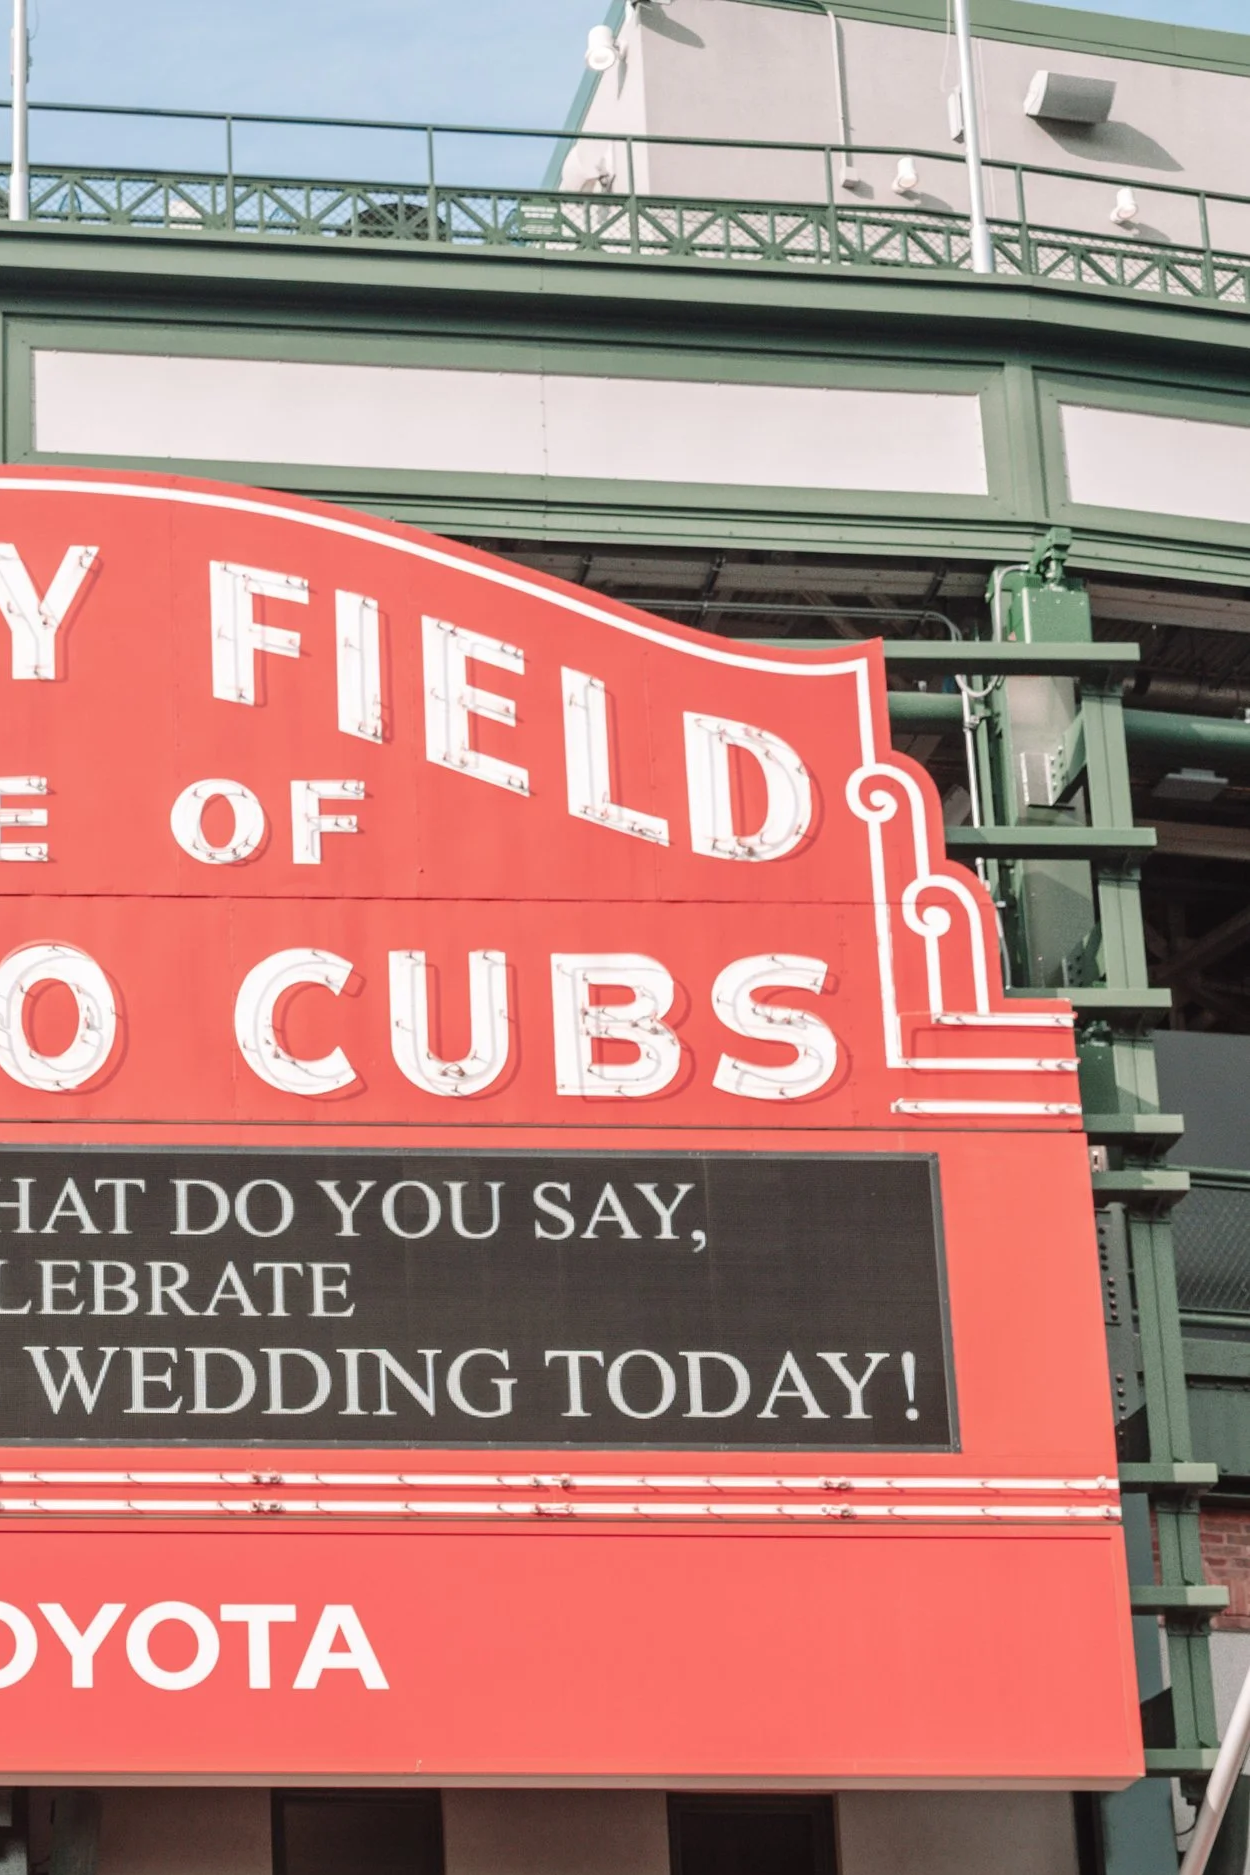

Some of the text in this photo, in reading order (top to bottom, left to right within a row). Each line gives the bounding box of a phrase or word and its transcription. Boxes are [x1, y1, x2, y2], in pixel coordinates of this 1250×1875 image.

[209, 559, 812, 863] FIELD
[170, 778, 366, 865] OF
[234, 948, 837, 1100] CUBS
[169, 1179, 294, 1238] DO
[316, 1180, 504, 1240] YOU
[533, 1181, 707, 1252] SAY,
[22, 1346, 518, 1418] WEDDING
[544, 1349, 920, 1421] TODAY!
